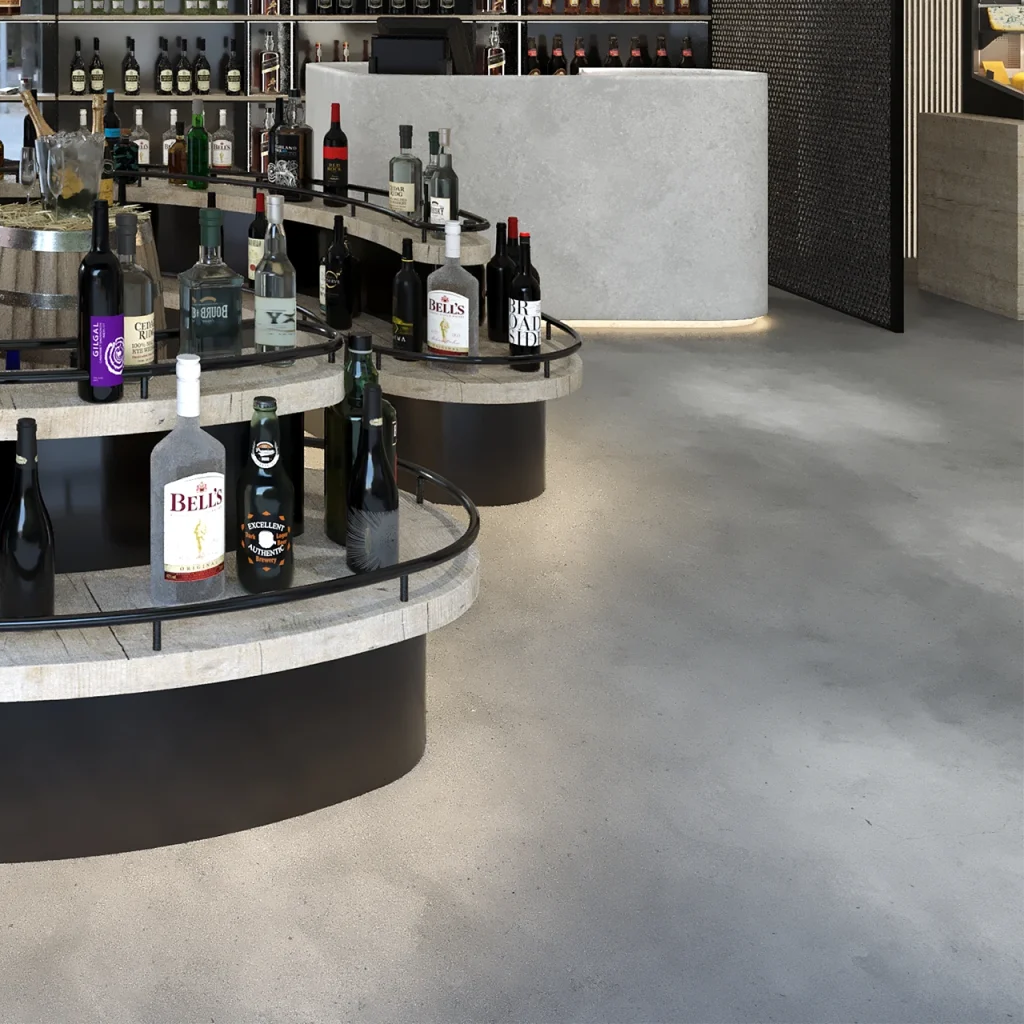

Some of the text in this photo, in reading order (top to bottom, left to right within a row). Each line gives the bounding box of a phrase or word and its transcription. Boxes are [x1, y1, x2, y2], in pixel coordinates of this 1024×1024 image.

[429, 298, 465, 316] BELL'S
[170, 487, 223, 513] BELL'S
[247, 521, 285, 532] EXCELLENT
[247, 544, 285, 557] AUTHENTIC
[255, 556, 277, 564] Brewery
